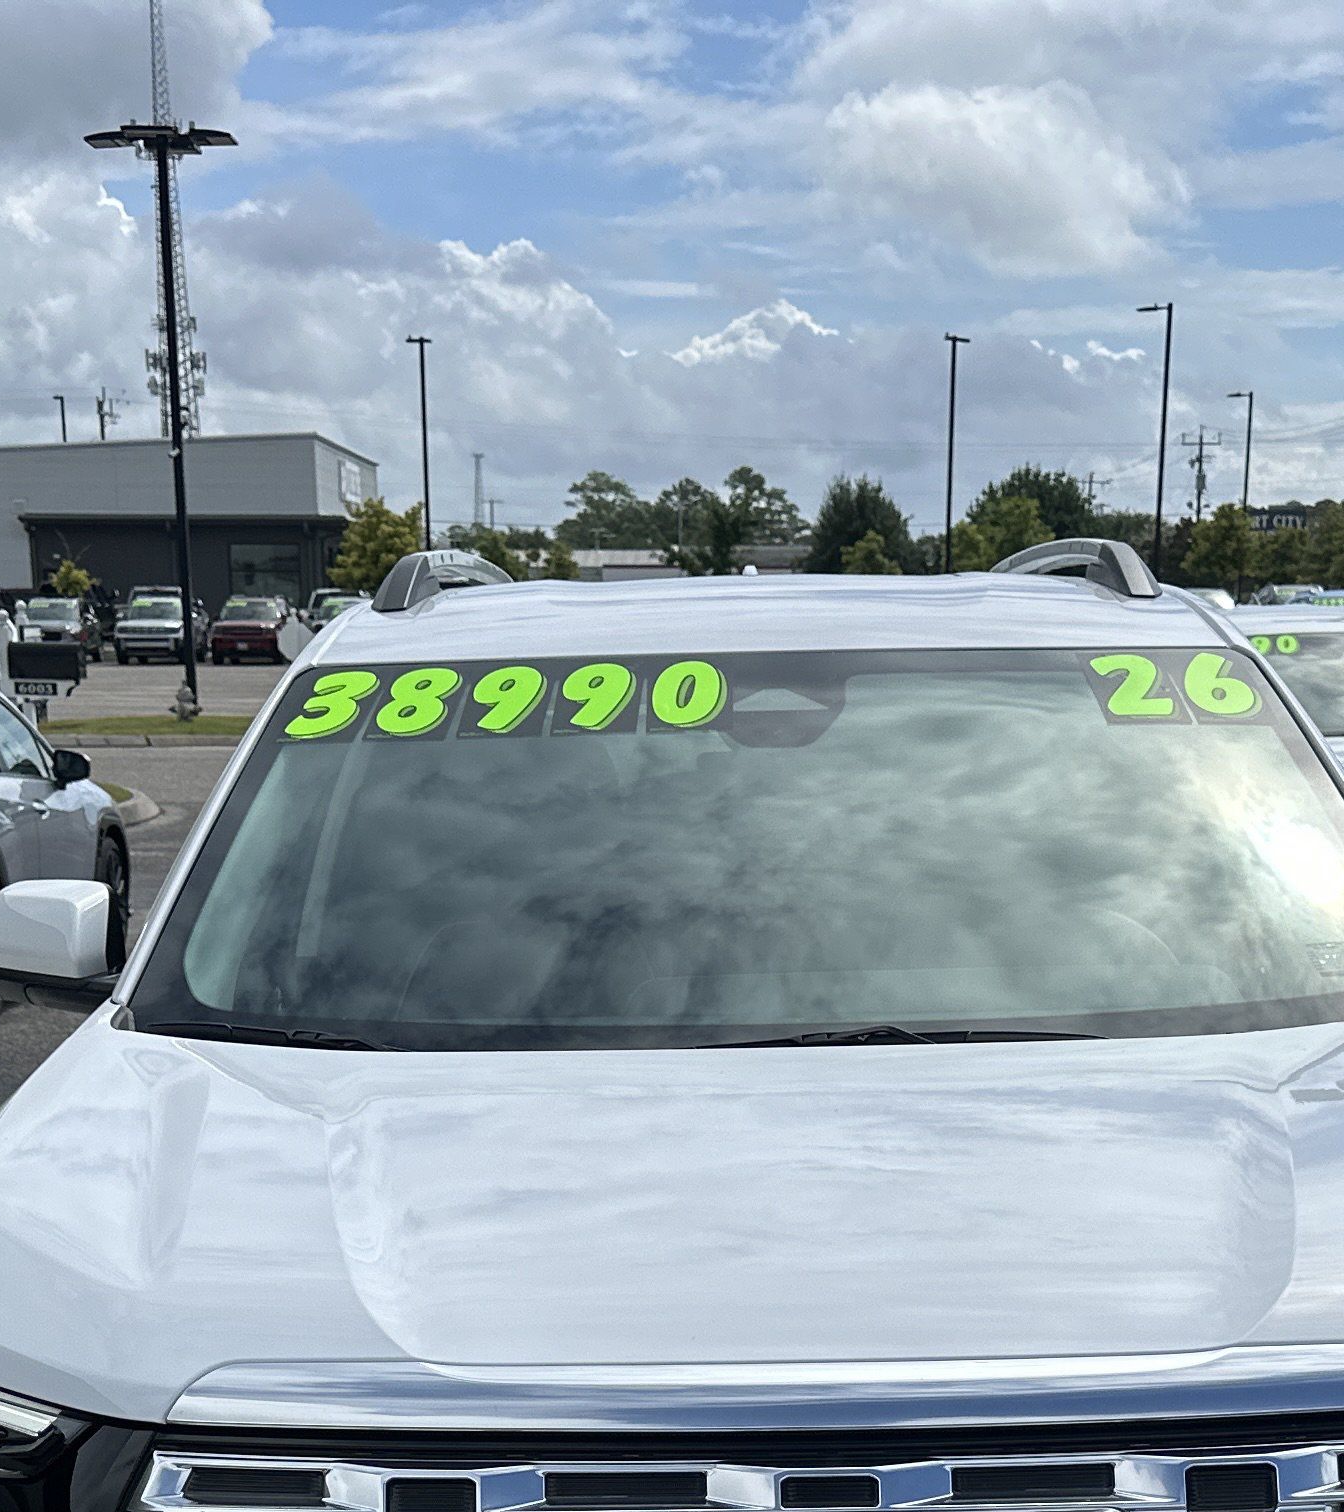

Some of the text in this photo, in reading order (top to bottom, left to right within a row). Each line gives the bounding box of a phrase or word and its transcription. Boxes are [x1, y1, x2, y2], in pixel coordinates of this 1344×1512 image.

[1273, 514, 1304, 528] CITY
[284, 651, 1262, 738] 38990 26
